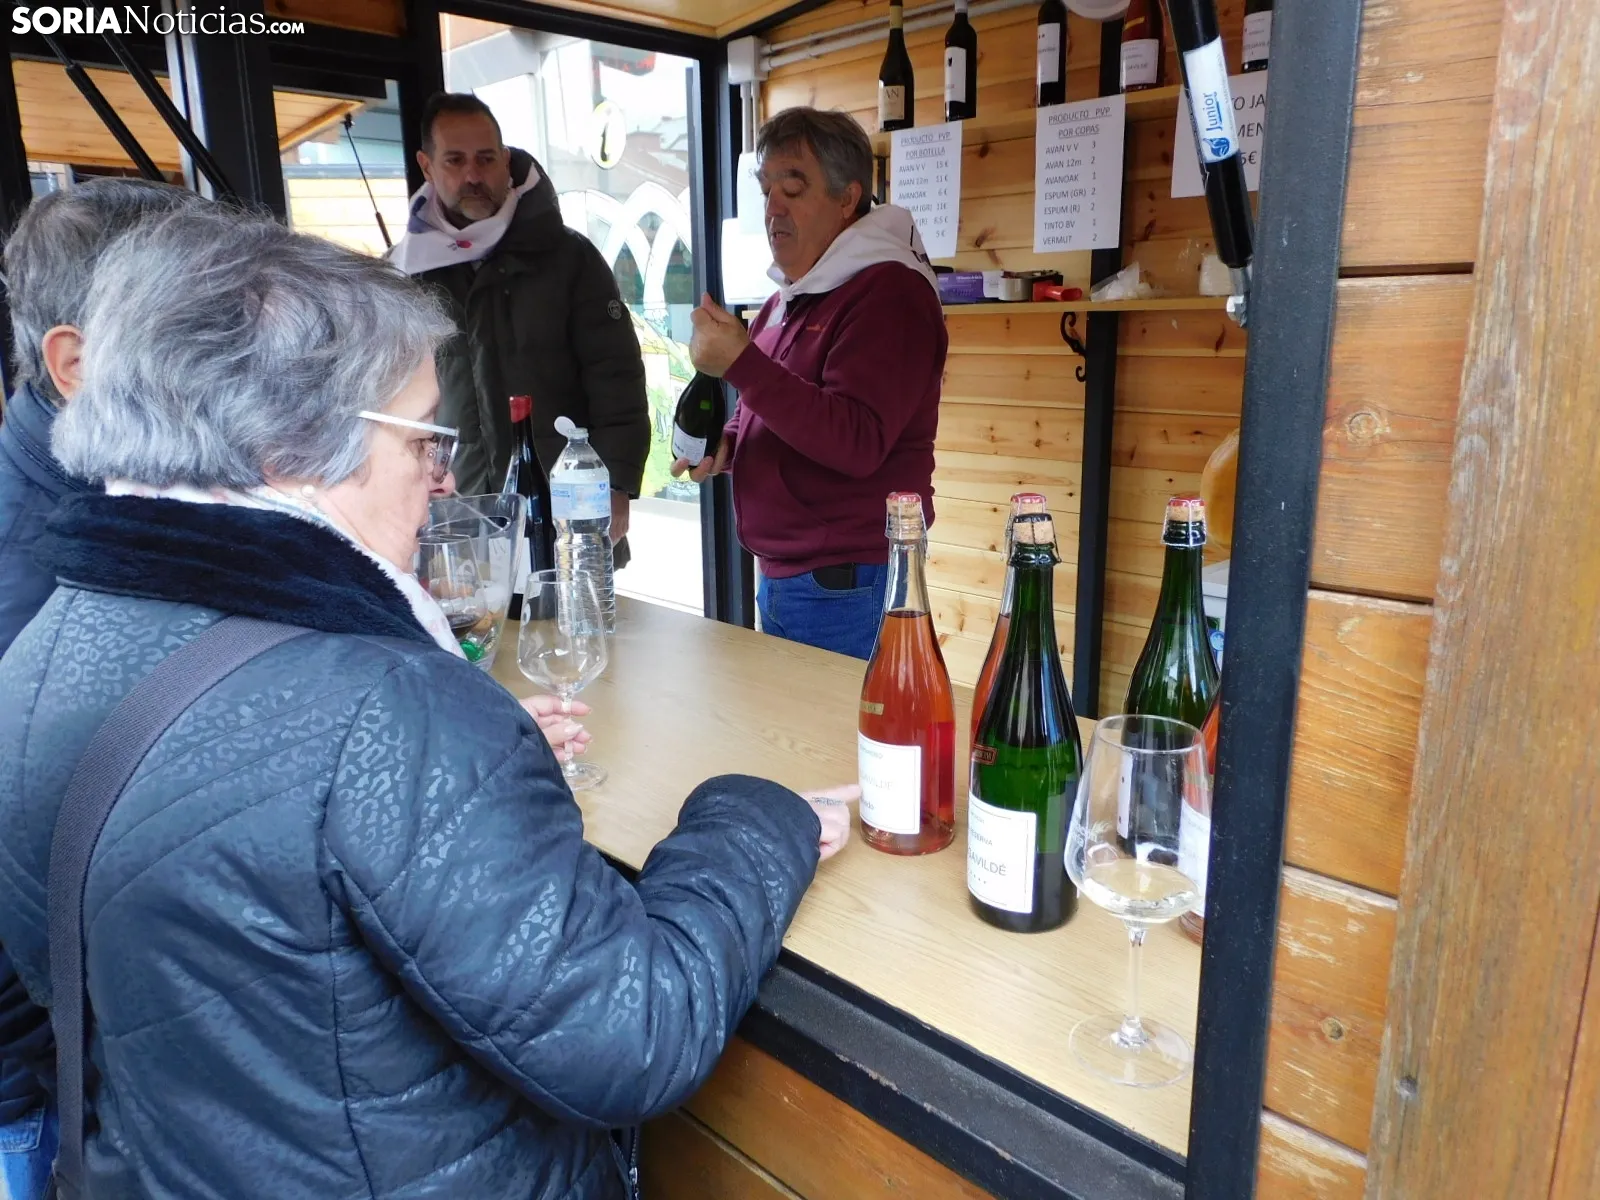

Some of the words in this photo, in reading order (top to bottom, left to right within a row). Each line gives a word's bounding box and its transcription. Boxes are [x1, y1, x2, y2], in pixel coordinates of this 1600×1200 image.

[1048, 109, 1089, 124] PRODUCTO
[1095, 107, 1111, 117] PVP
[1202, 91, 1223, 132] Junior
[1058, 129, 1074, 138] POR
[1075, 125, 1100, 136] COPAS
[900, 134, 934, 146] PRODUCTO
[905, 150, 918, 159] POR
[918, 147, 946, 157] BOTELLA
[1045, 145, 1065, 155] AVAN
[898, 164, 915, 173] AVAN
[944, 160, 949, 168] €
[1045, 161, 1064, 170] AVAN
[1066, 159, 1082, 167] 12m
[898, 179, 915, 187] AVAN
[1044, 174, 1079, 185] AVANOAK
[898, 191, 927, 200] AVANOAK
[1044, 191, 1069, 200] ESPUM
[1070, 189, 1086, 199] (GR)
[1091, 188, 1096, 196] 2
[1044, 206, 1068, 215] ESPUM
[1070, 204, 1080, 213] (R)
[1090, 203, 1095, 211] 2
[943, 216, 949, 224] €
[1044, 222, 1065, 230] TINTO
[936, 230, 941, 238] 5
[1043, 235, 1072, 245] VERMUT
[1092, 234, 1097, 242] 2
